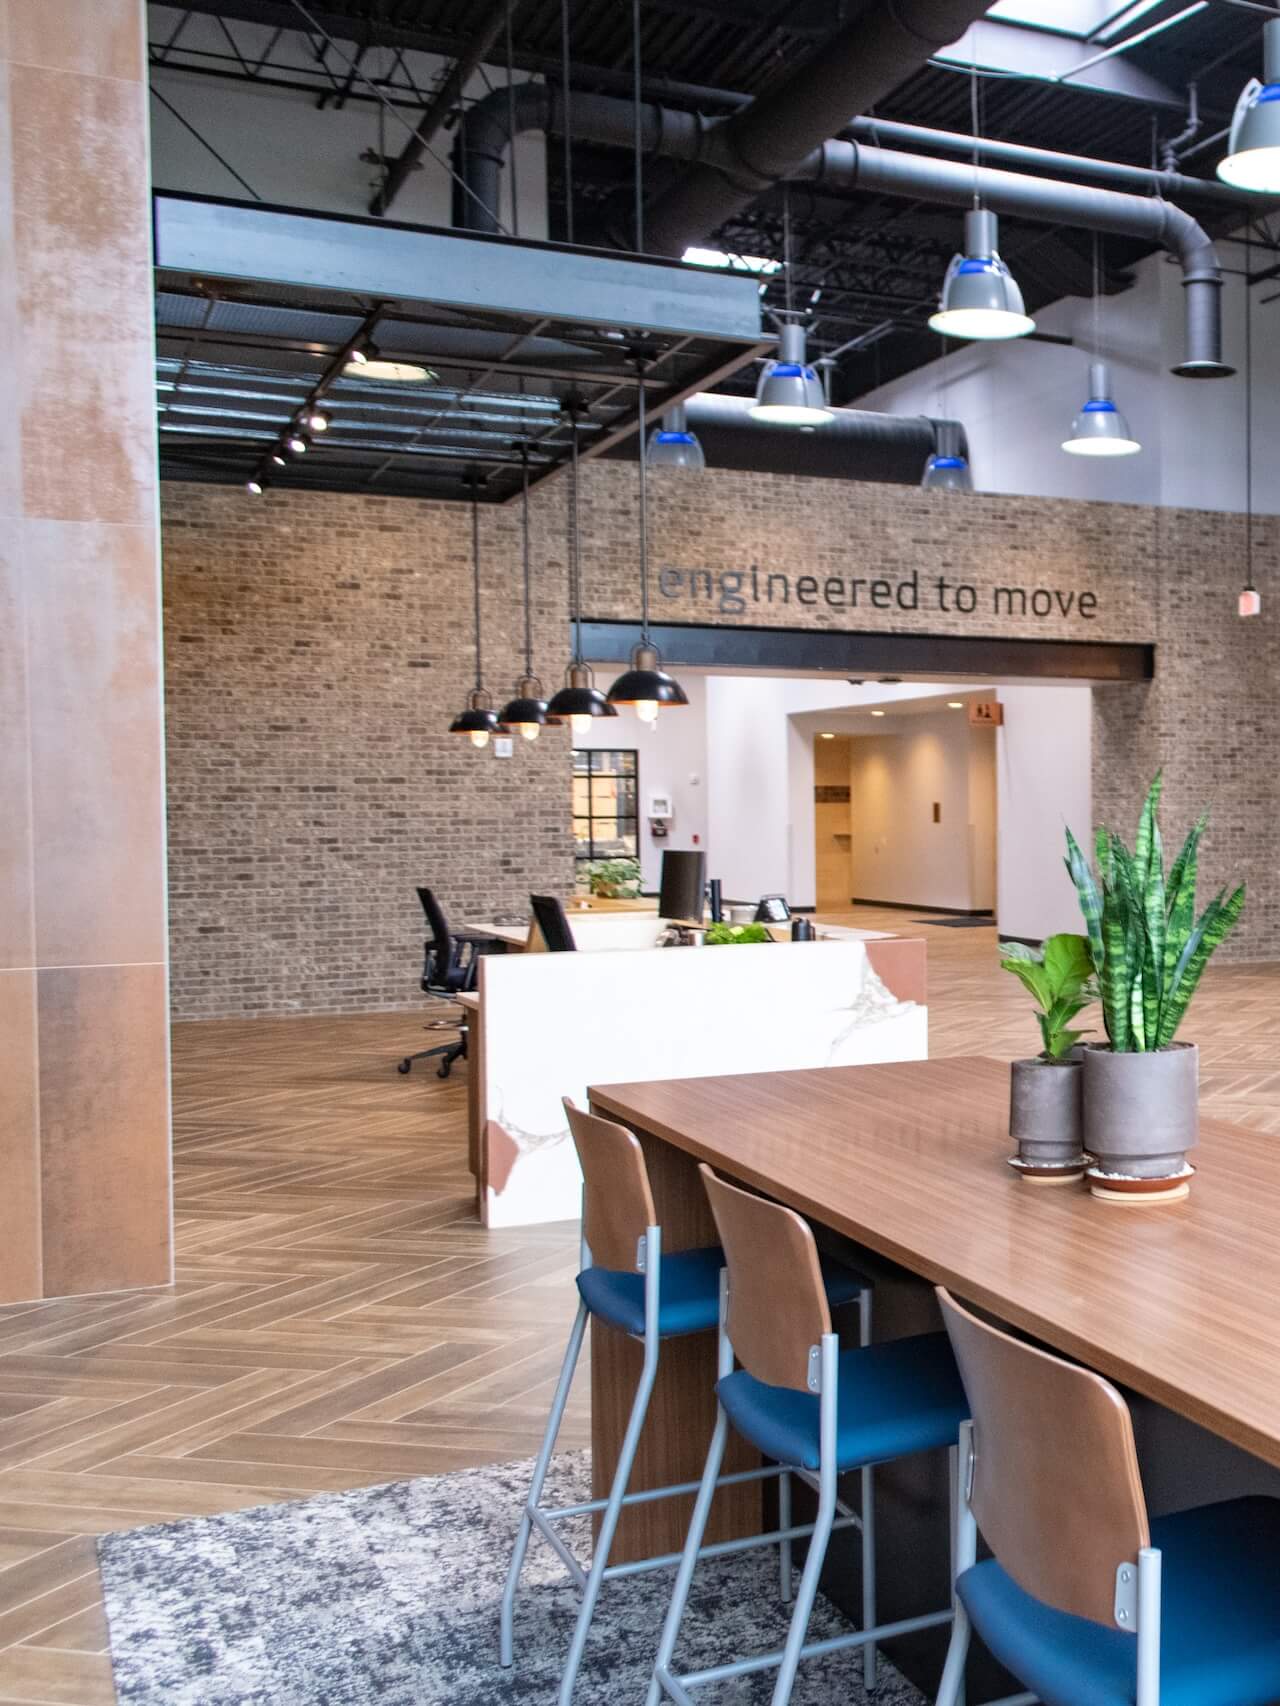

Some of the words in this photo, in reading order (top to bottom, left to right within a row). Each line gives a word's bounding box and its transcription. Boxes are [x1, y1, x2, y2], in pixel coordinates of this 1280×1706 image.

[659, 564, 919, 614] engineered
[935, 576, 977, 613] to
[994, 587, 1098, 618] move
